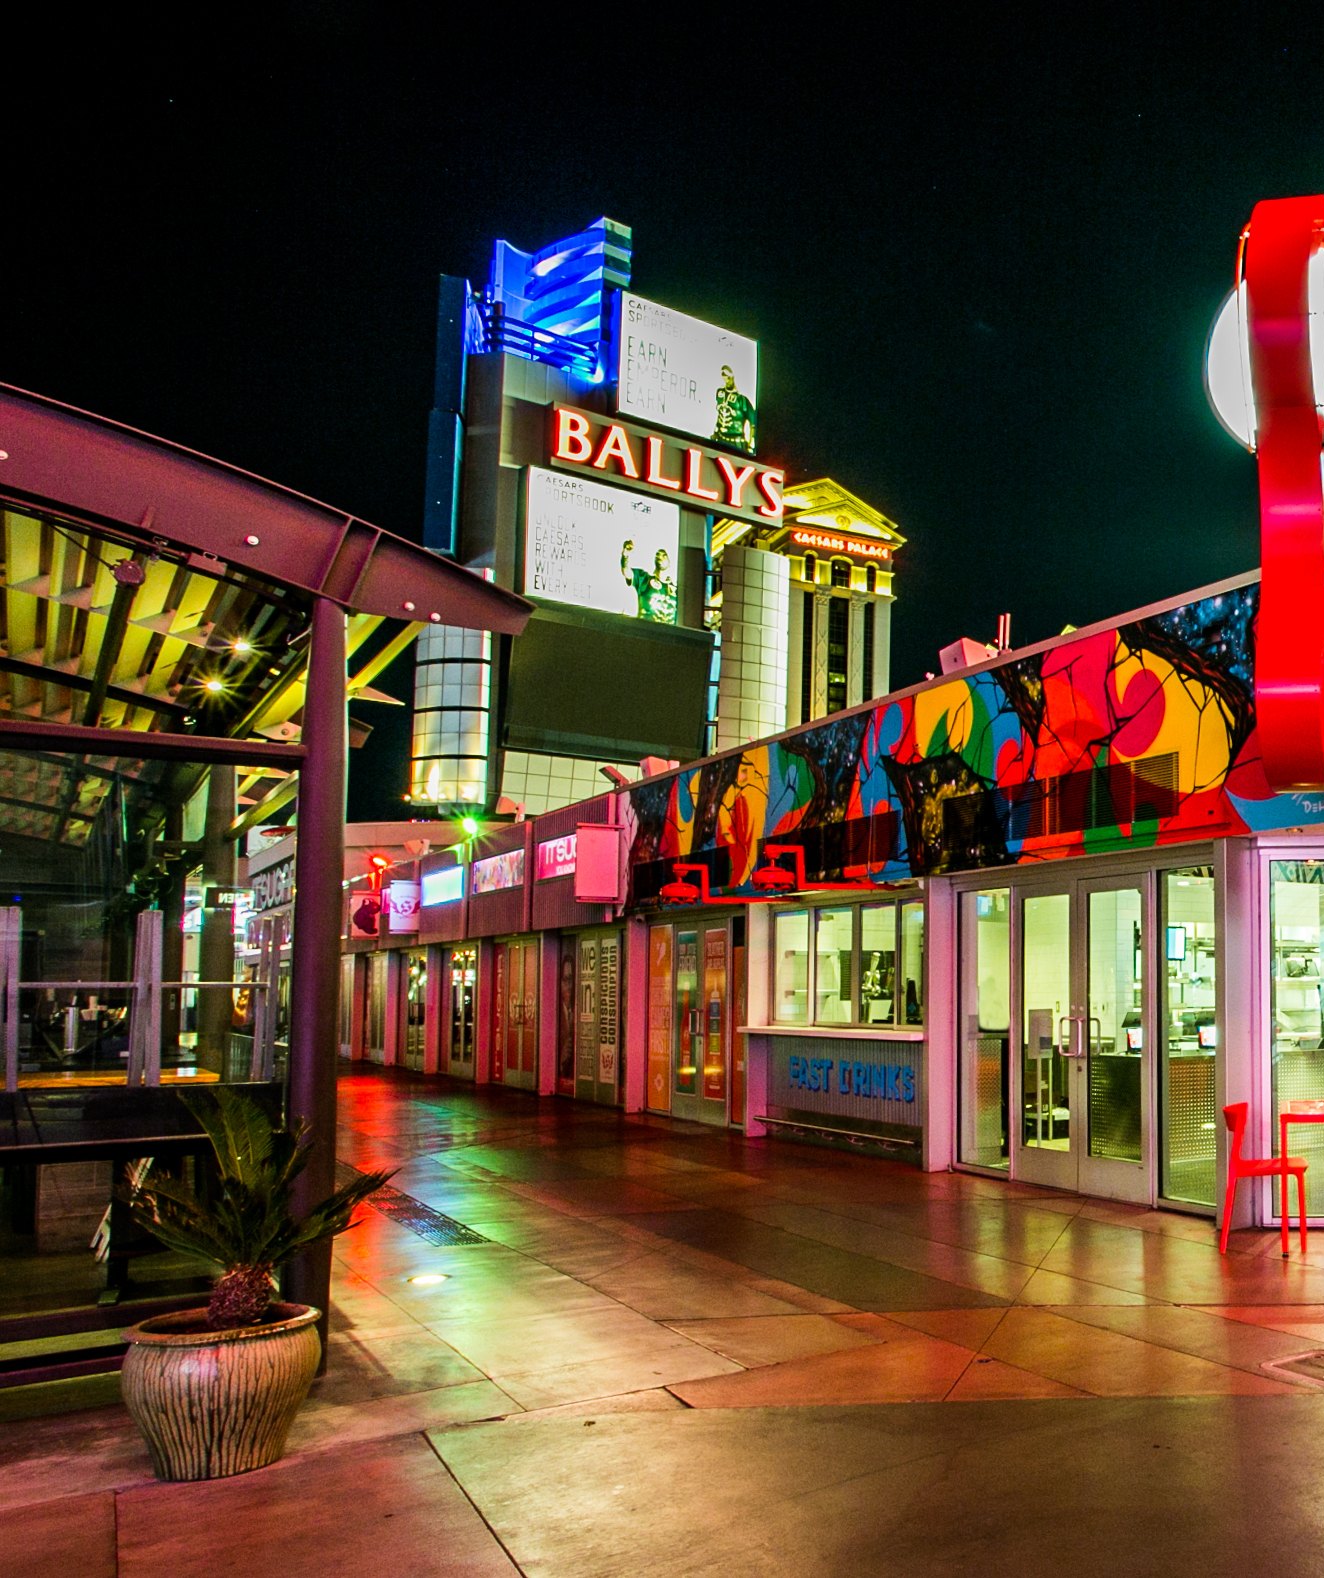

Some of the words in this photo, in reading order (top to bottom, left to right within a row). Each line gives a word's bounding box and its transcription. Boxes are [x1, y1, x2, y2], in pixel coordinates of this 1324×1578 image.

[627, 335, 668, 368] EARN
[626, 381, 666, 414] EARN
[555, 408, 783, 518] BALLYS
[537, 485, 615, 515] PORTSBOOK
[792, 532, 844, 551] CAESARS
[846, 541, 889, 560] PALACE
[534, 574, 568, 594] EVERY
[789, 1054, 834, 1093] FAST
[838, 1058, 916, 1103] DRINKS
